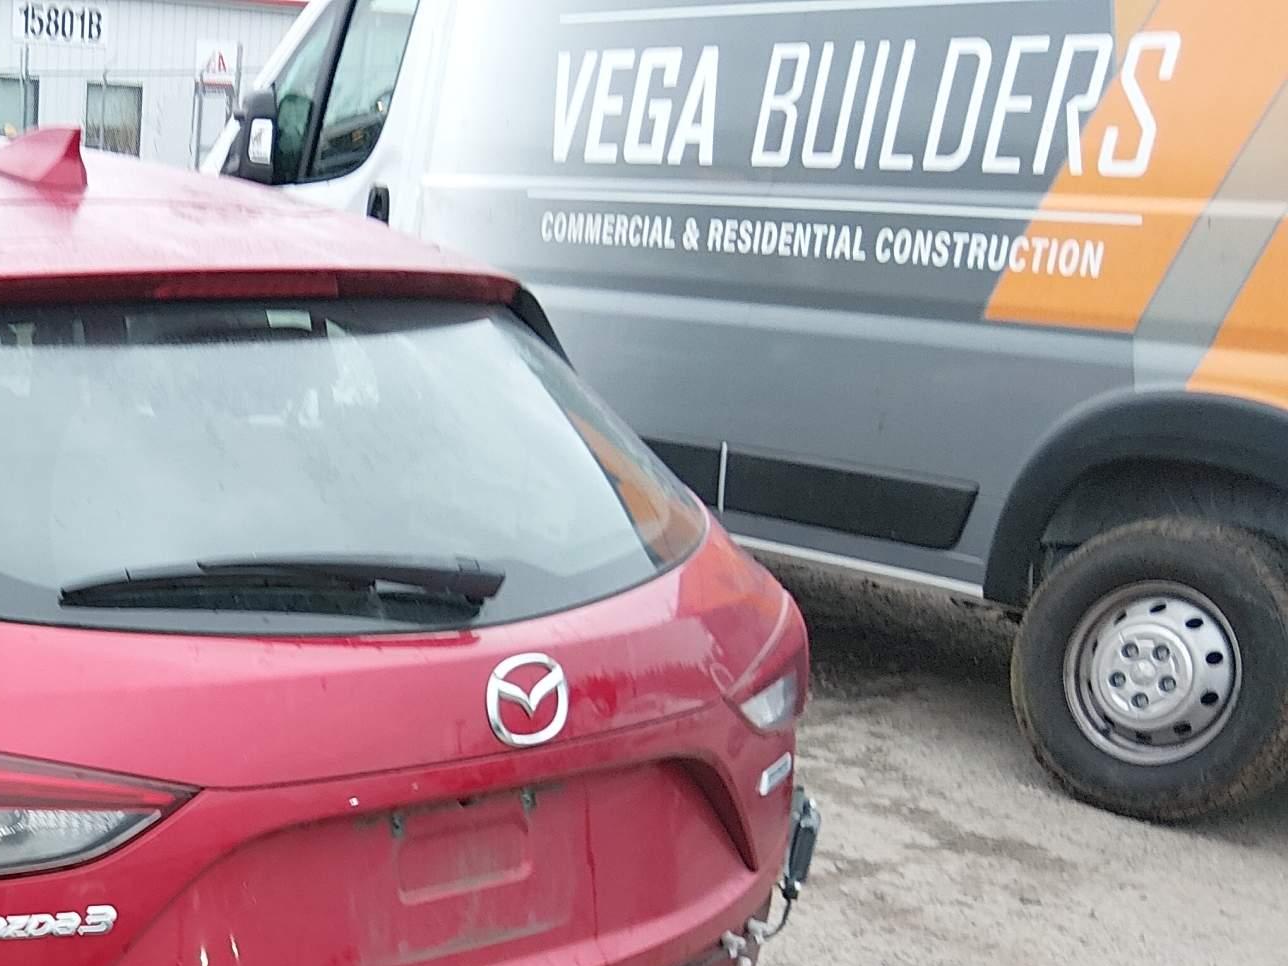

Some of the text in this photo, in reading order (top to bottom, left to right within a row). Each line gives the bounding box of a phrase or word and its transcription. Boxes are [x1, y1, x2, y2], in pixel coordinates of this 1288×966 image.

[19, 3, 103, 41] 15801B
[552, 31, 1182, 178] VEGA BUILDERS
[540, 210, 1105, 280] COMMERCIAL & RESIDENTIAL CONSTRUCTION
